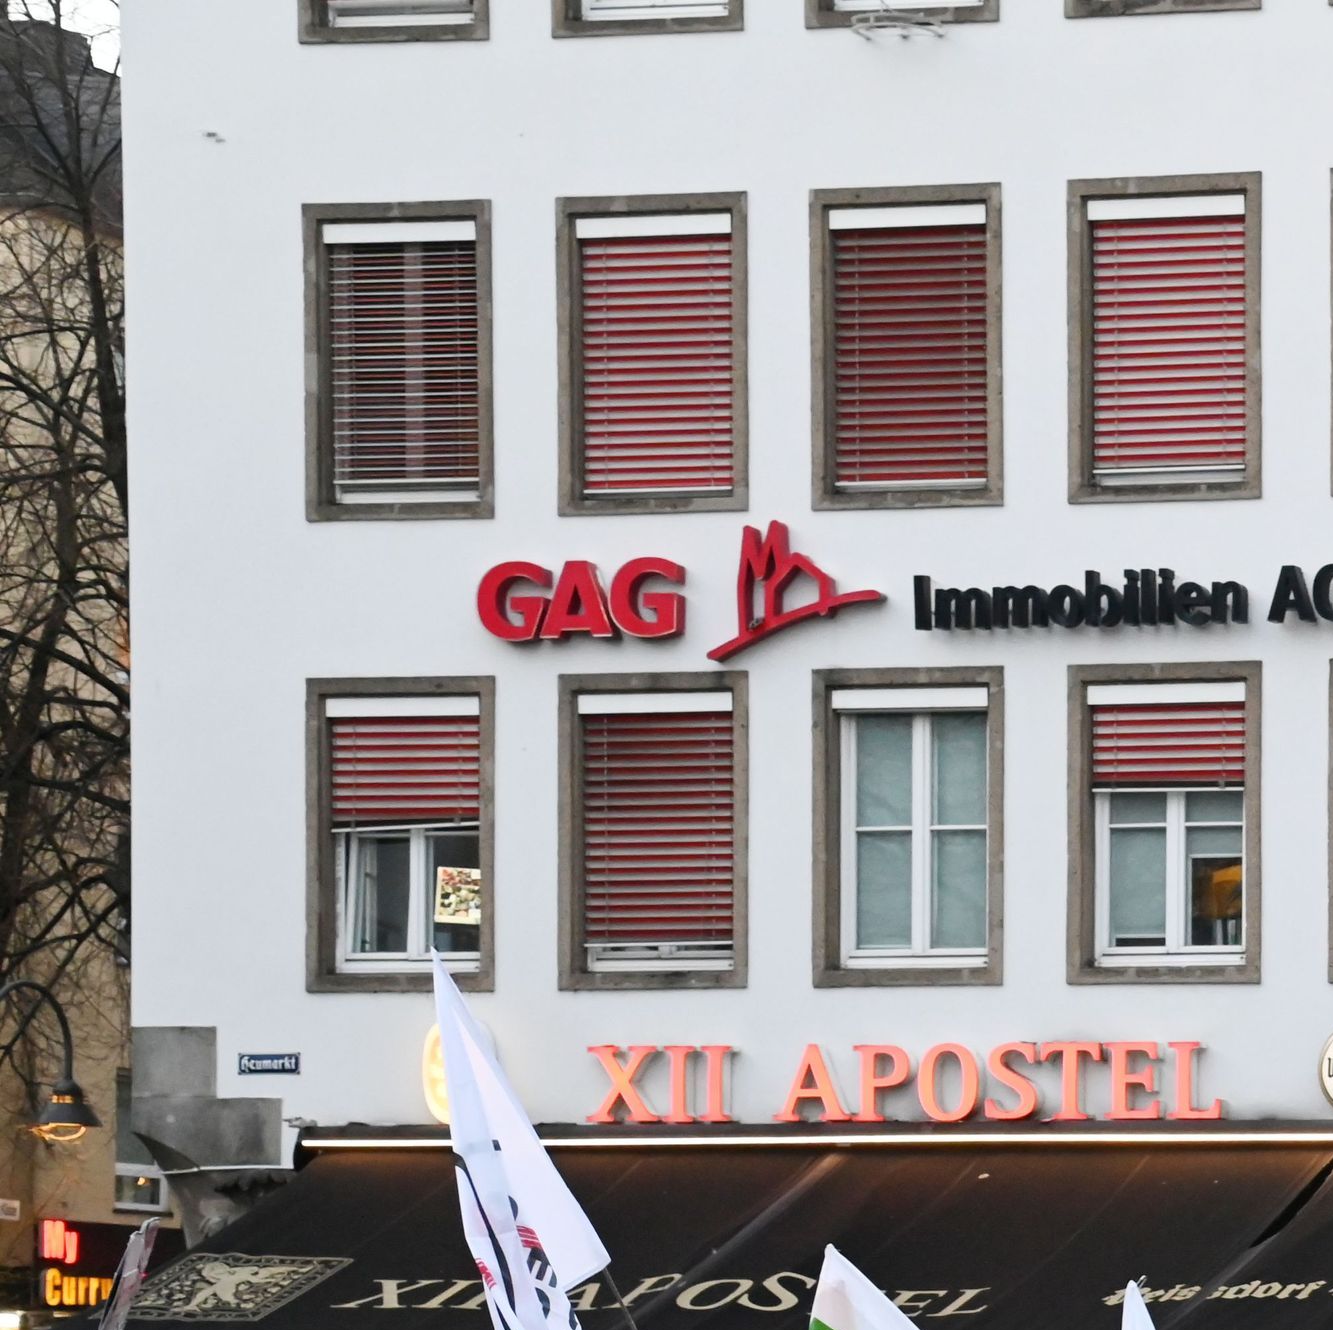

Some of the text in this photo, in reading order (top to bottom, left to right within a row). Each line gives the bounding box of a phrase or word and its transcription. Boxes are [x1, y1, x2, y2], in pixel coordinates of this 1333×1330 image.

[477, 556, 686, 642] GAG
[913, 568, 1249, 633] Immobilien
[586, 1041, 1222, 1124] XII APOSTEL
[42, 1219, 79, 1264] My
[566, 1271, 990, 1318] APOSEL
